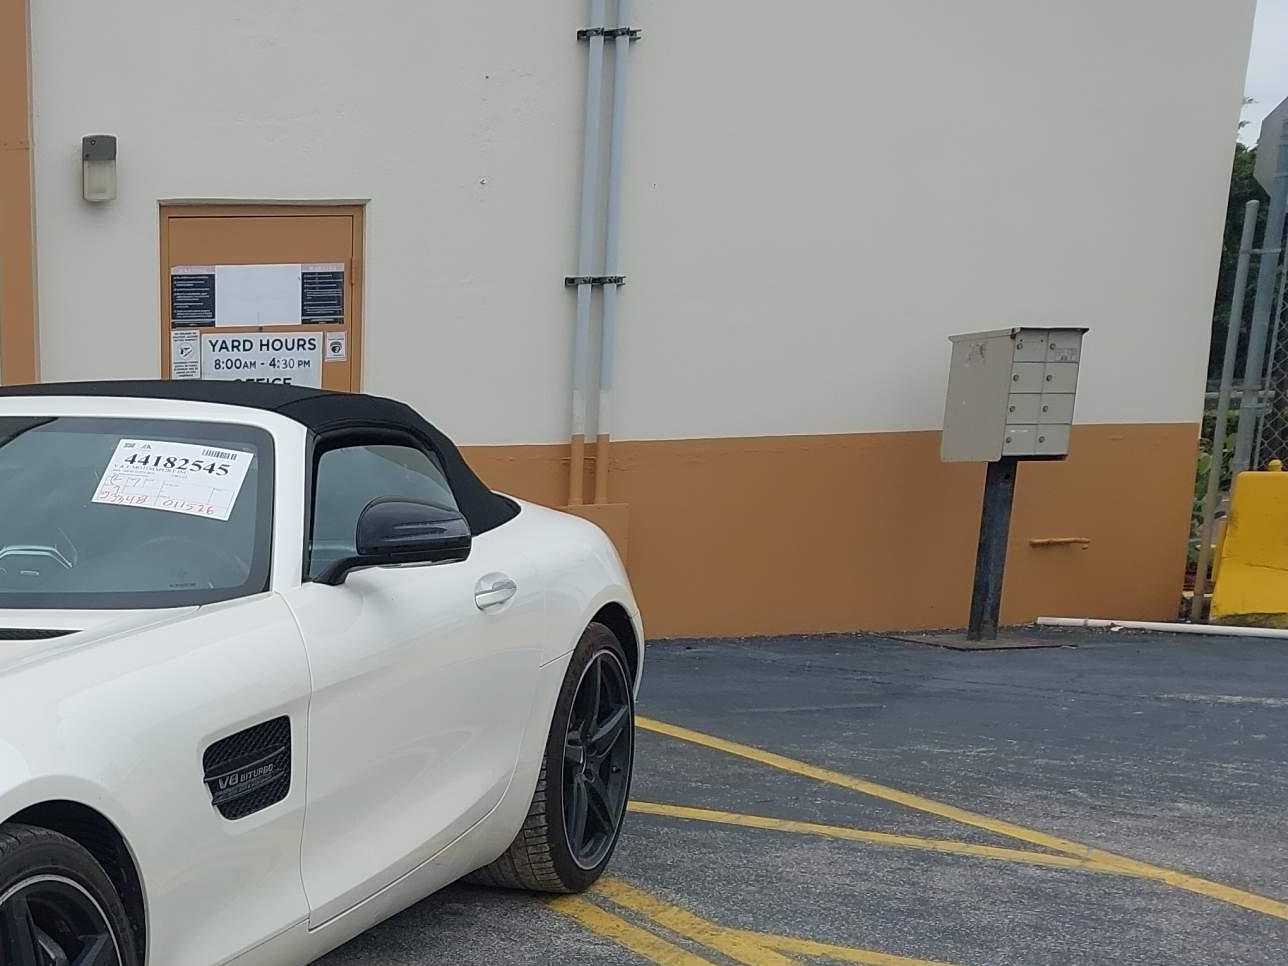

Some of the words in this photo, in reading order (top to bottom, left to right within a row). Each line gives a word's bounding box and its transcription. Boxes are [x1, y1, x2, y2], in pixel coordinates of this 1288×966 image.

[209, 339, 253, 352] YARD
[259, 338, 317, 352] HOURS
[269, 357, 295, 370] 4:30
[297, 359, 311, 368] PM
[124, 453, 231, 476] 44182545
[218, 773, 239, 790] V8
